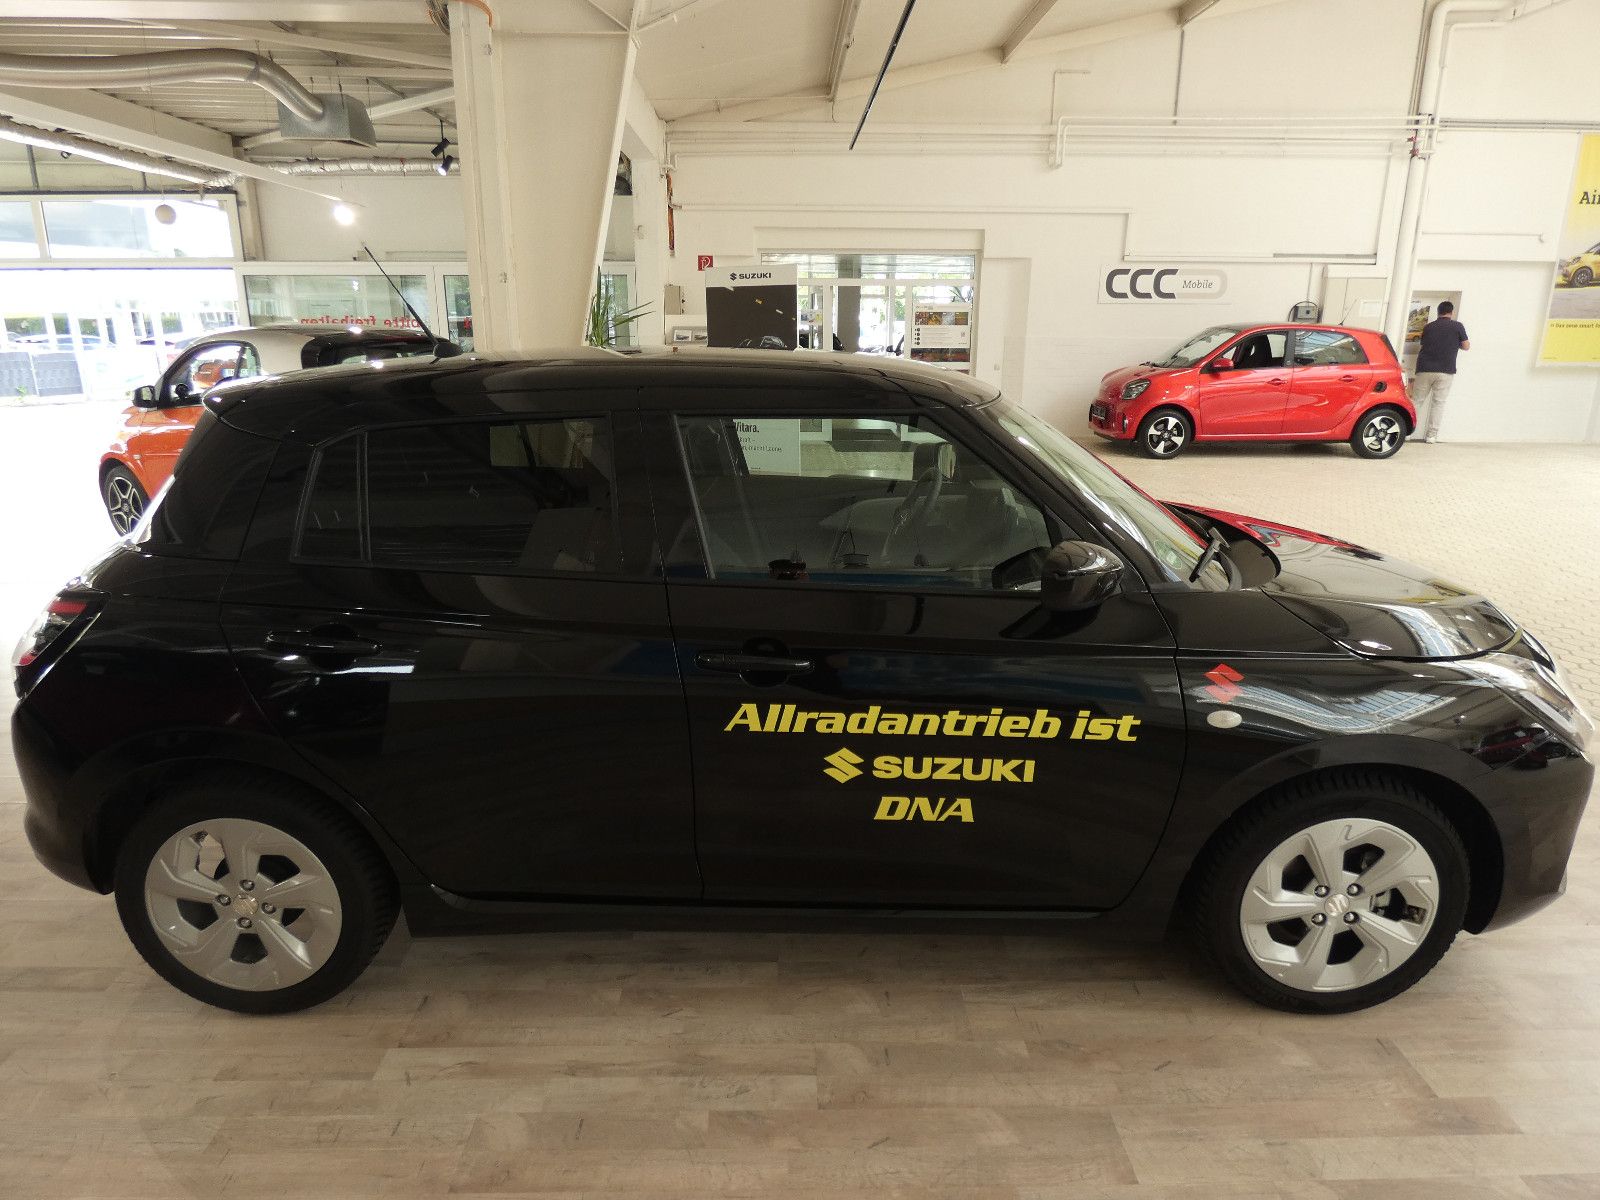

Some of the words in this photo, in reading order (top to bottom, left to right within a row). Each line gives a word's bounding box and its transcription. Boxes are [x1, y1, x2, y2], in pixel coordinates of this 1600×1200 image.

[1106, 268, 1179, 299] CCC
[1182, 280, 1213, 289] Mobile
[725, 704, 1061, 738] Allradantrieb
[1071, 711, 1141, 741] ist
[873, 756, 1035, 782] SUZUKI
[874, 797, 974, 822] DNA
